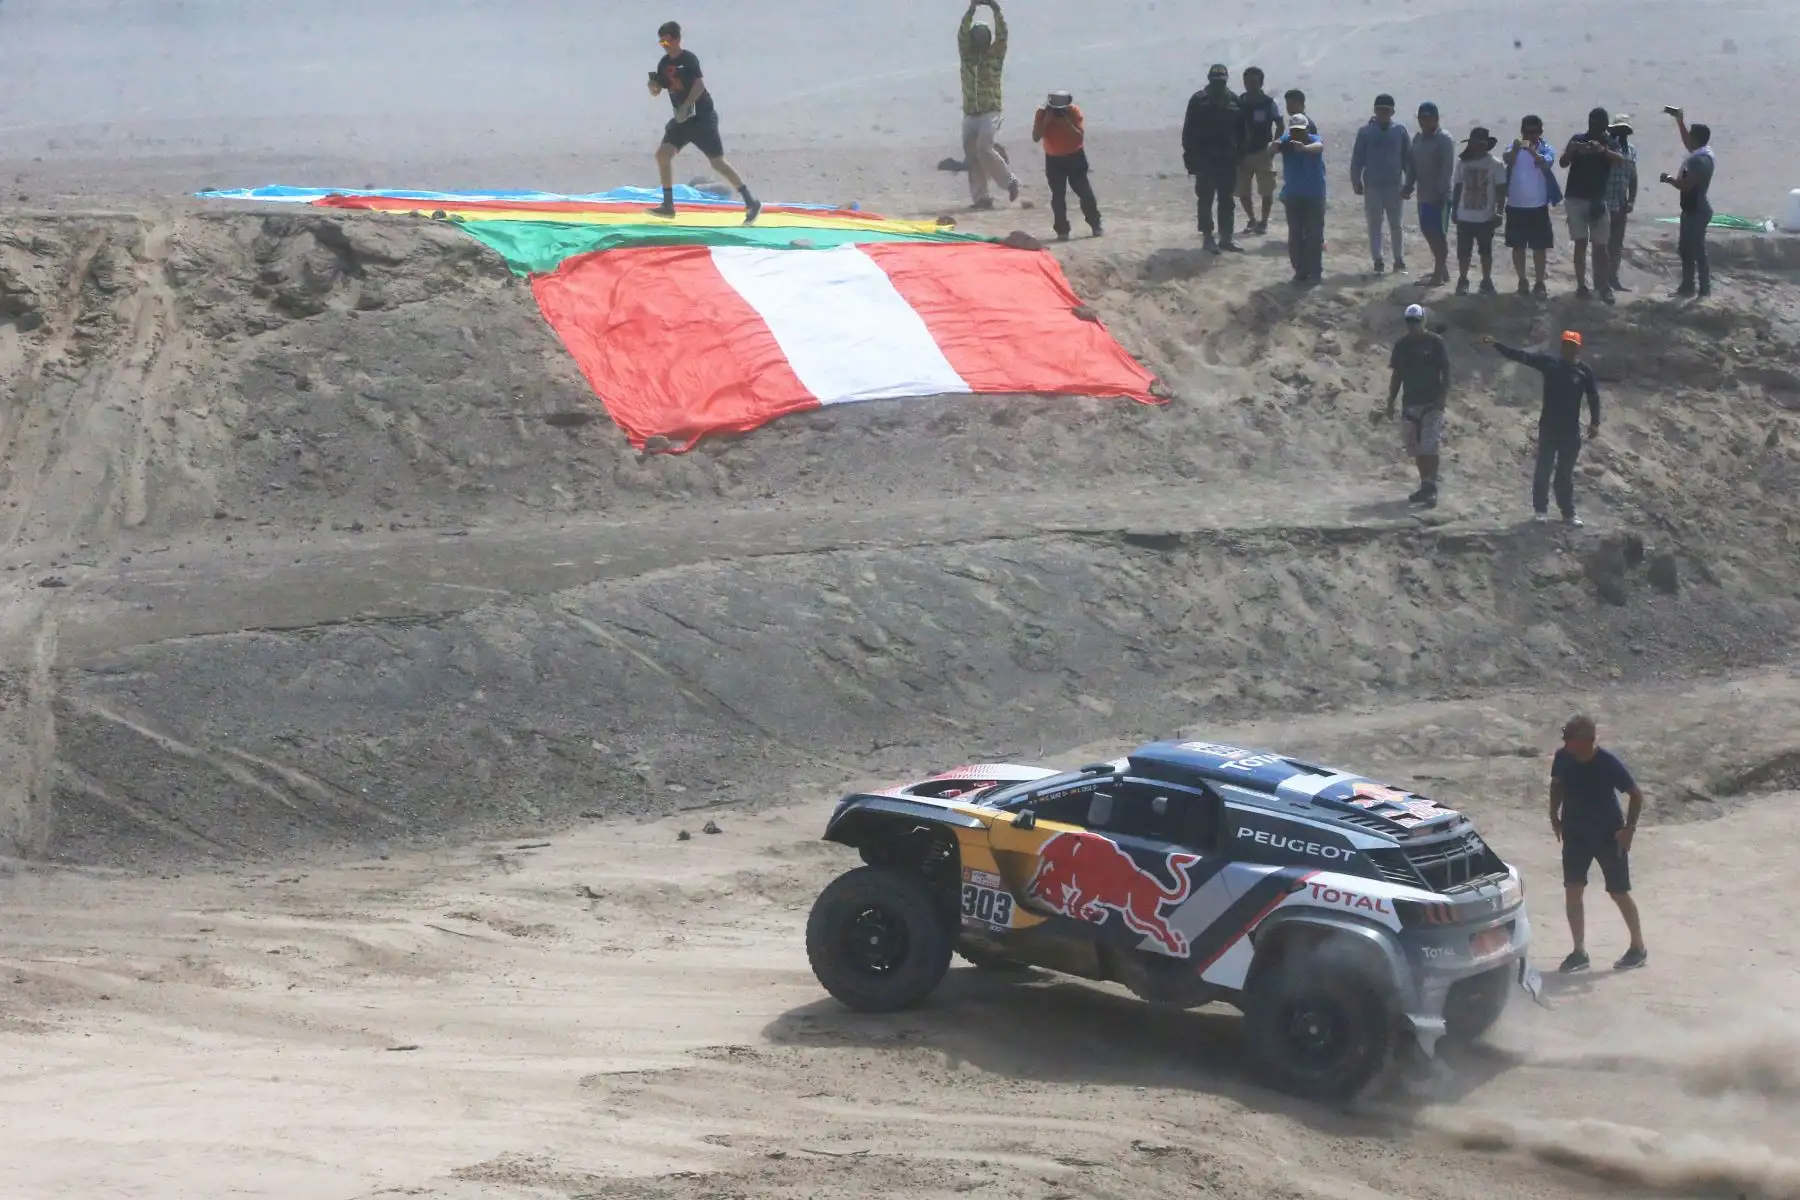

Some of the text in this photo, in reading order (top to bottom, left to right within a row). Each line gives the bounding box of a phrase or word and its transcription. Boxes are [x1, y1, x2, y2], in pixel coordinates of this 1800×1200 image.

[1236, 826, 1356, 861] PEUGEOT
[962, 885, 1012, 925] 303
[1308, 882, 1390, 914] TOTAL
